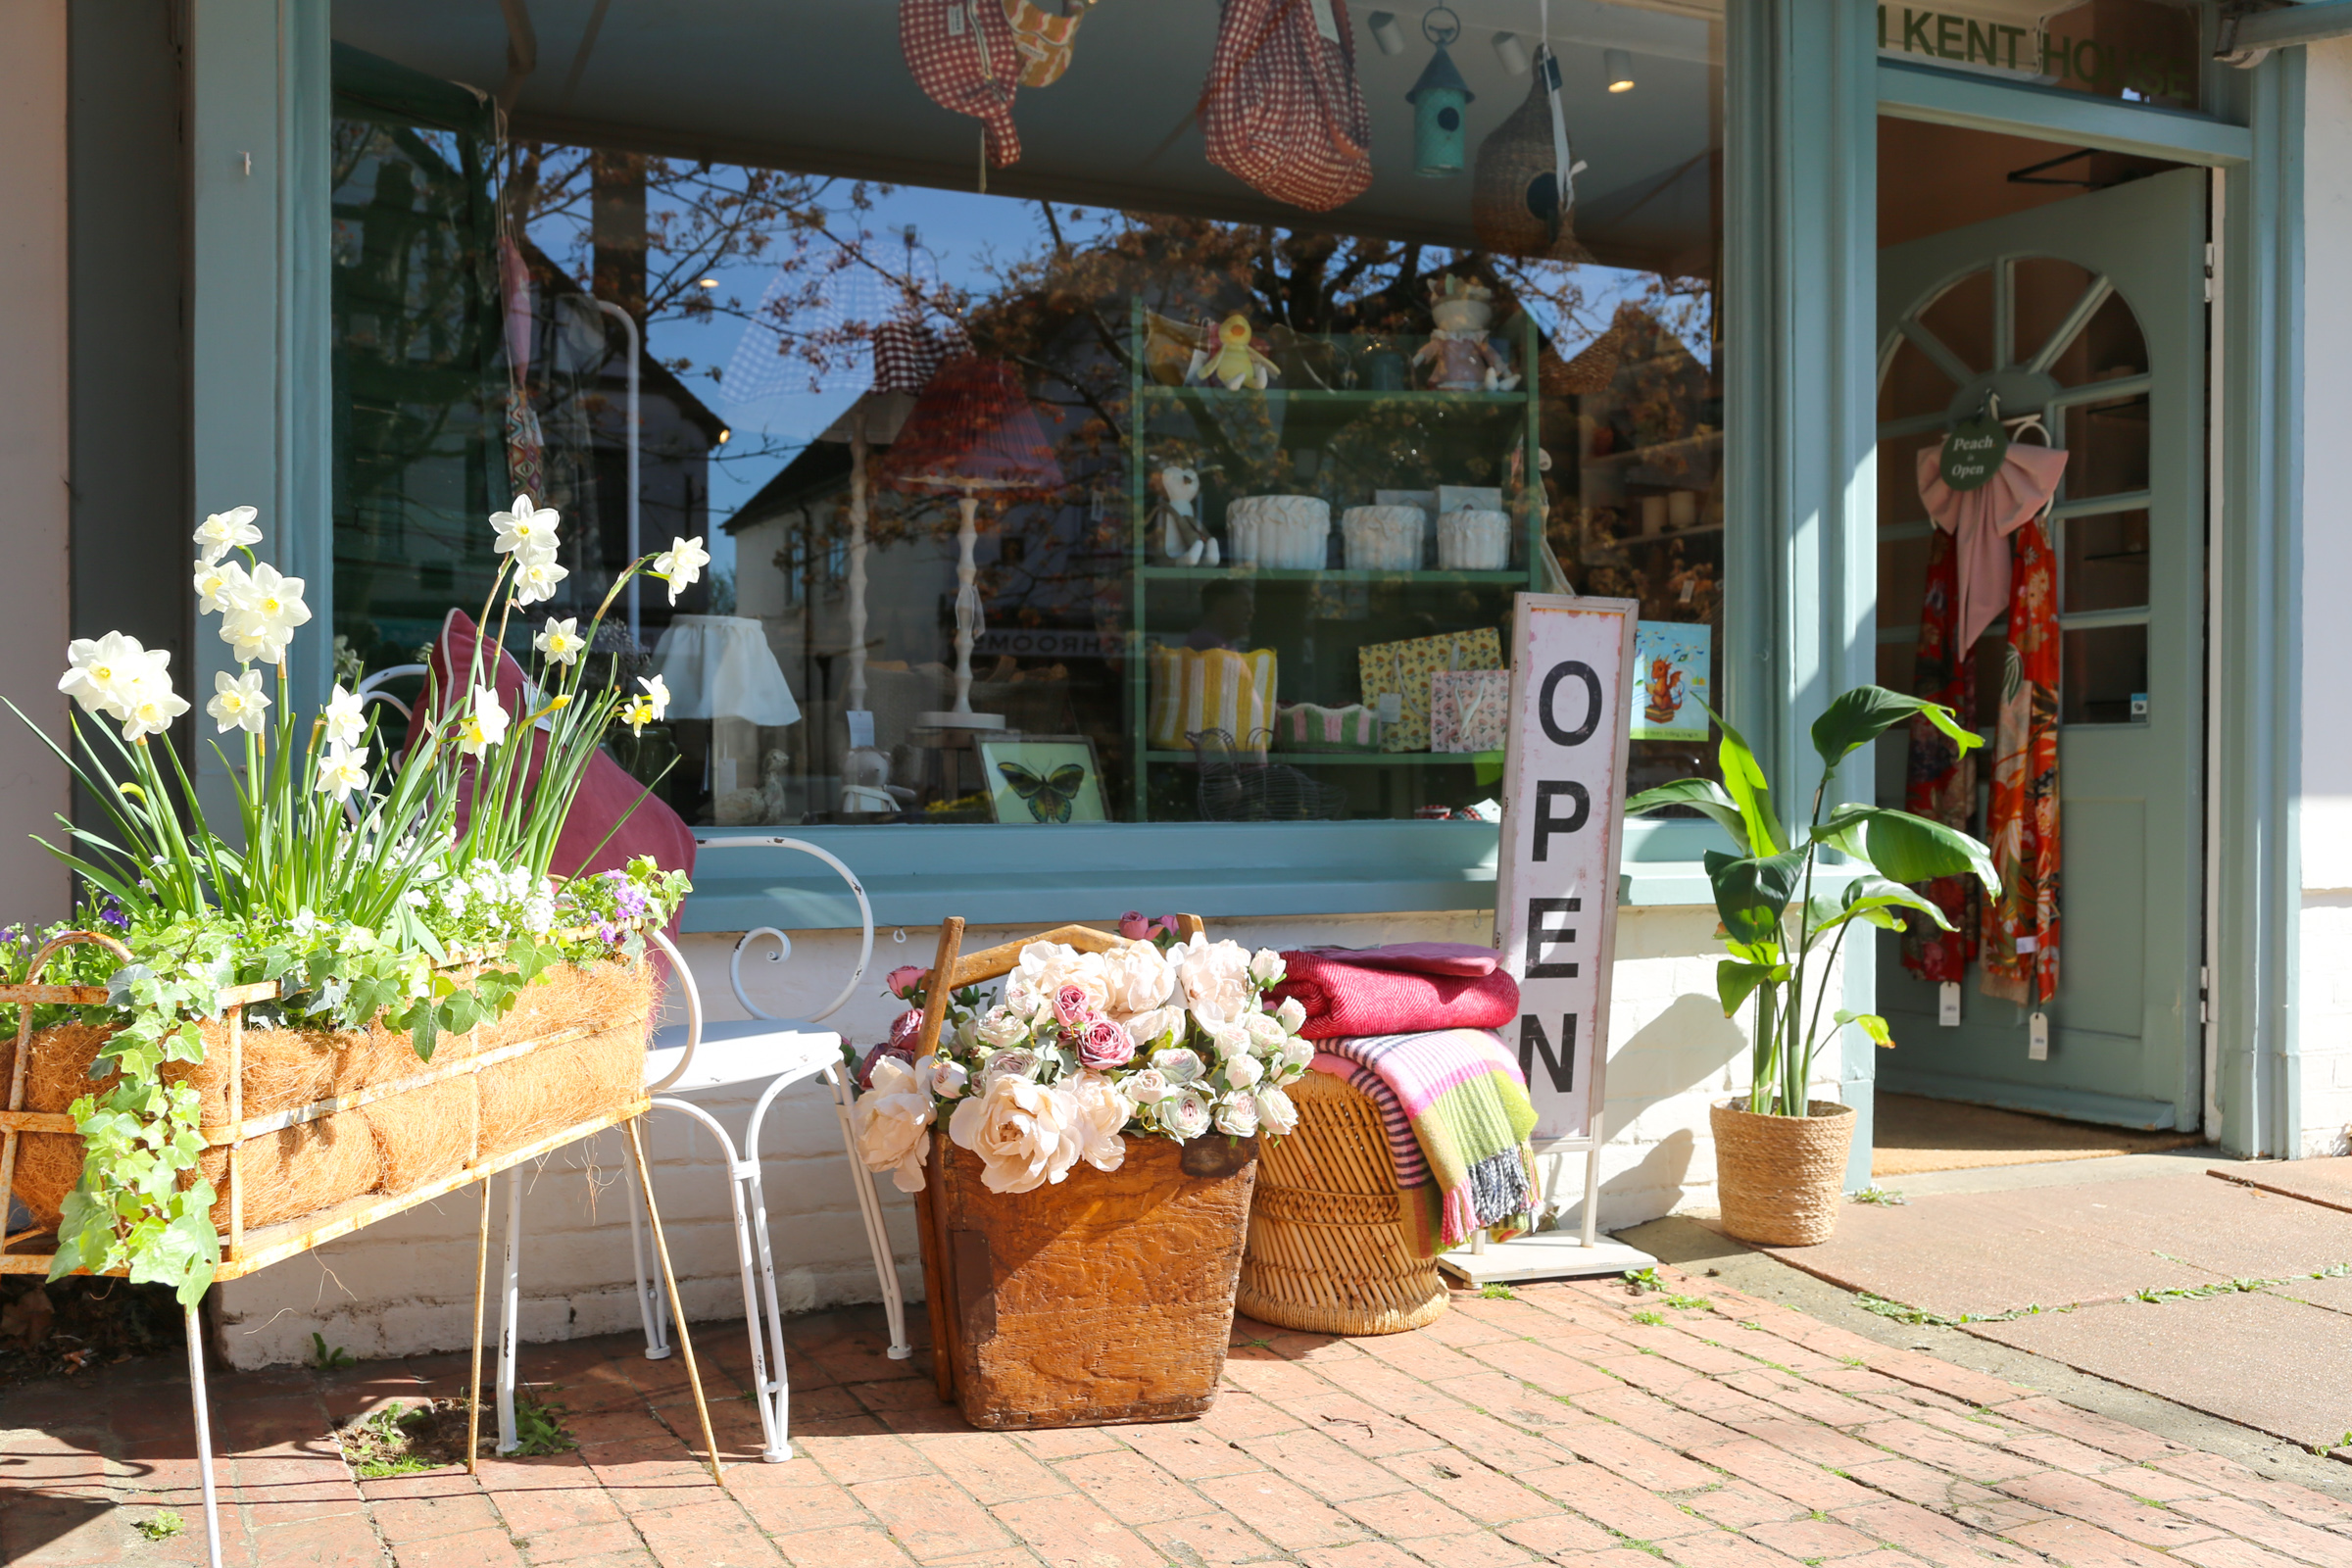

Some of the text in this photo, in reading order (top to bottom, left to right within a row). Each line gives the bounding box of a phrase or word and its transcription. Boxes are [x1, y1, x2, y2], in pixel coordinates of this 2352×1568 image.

[1903, 8, 2027, 70] KENT
[2043, 32, 2191, 100] HOUSE
[1952, 465, 1984, 479] Open
[1517, 660, 1603, 1094] OPEN
